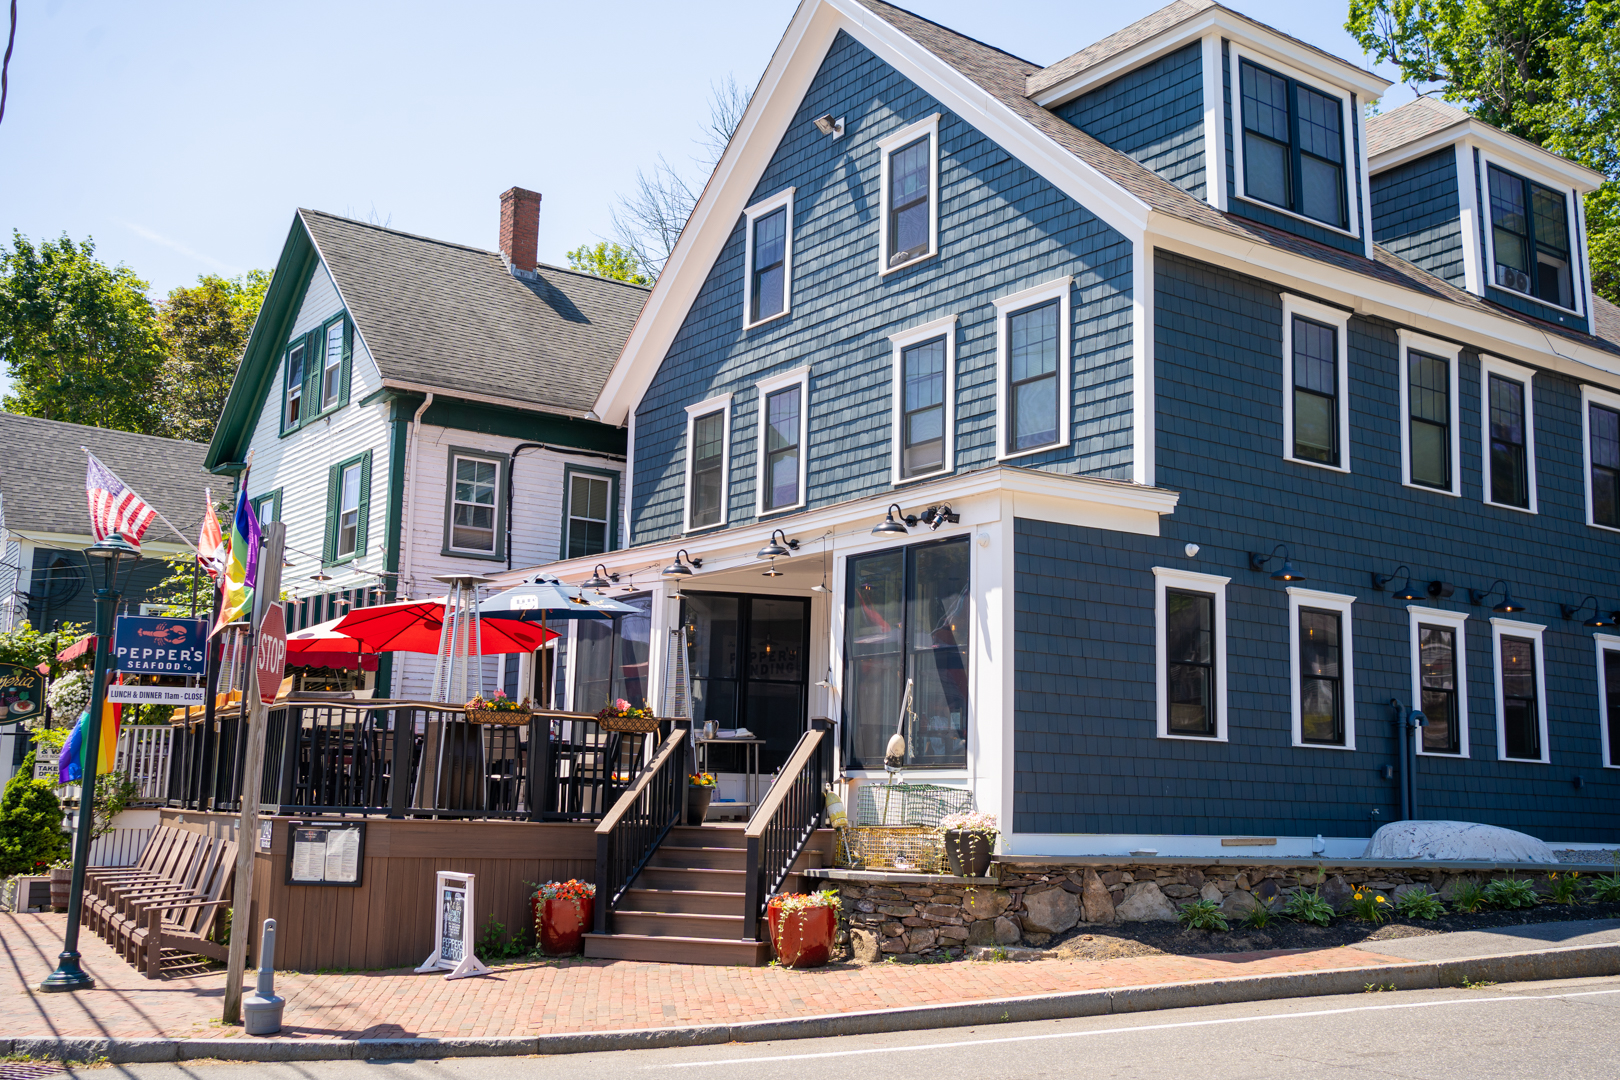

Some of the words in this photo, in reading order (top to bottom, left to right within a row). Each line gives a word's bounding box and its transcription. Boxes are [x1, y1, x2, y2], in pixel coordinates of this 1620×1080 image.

[117, 647, 203, 662] PEPPER'S
[259, 633, 284, 674] STOP
[730, 646, 796, 664] PPPER'S
[127, 661, 180, 670] SEAFOOD
[731, 662, 794, 677] LNDING
[110, 690, 131, 699] LUNCH
[132, 691, 138, 699] &
[139, 691, 163, 700] DINNER
[164, 692, 180, 700] 11am
[184, 692, 203, 701] CLOSE
